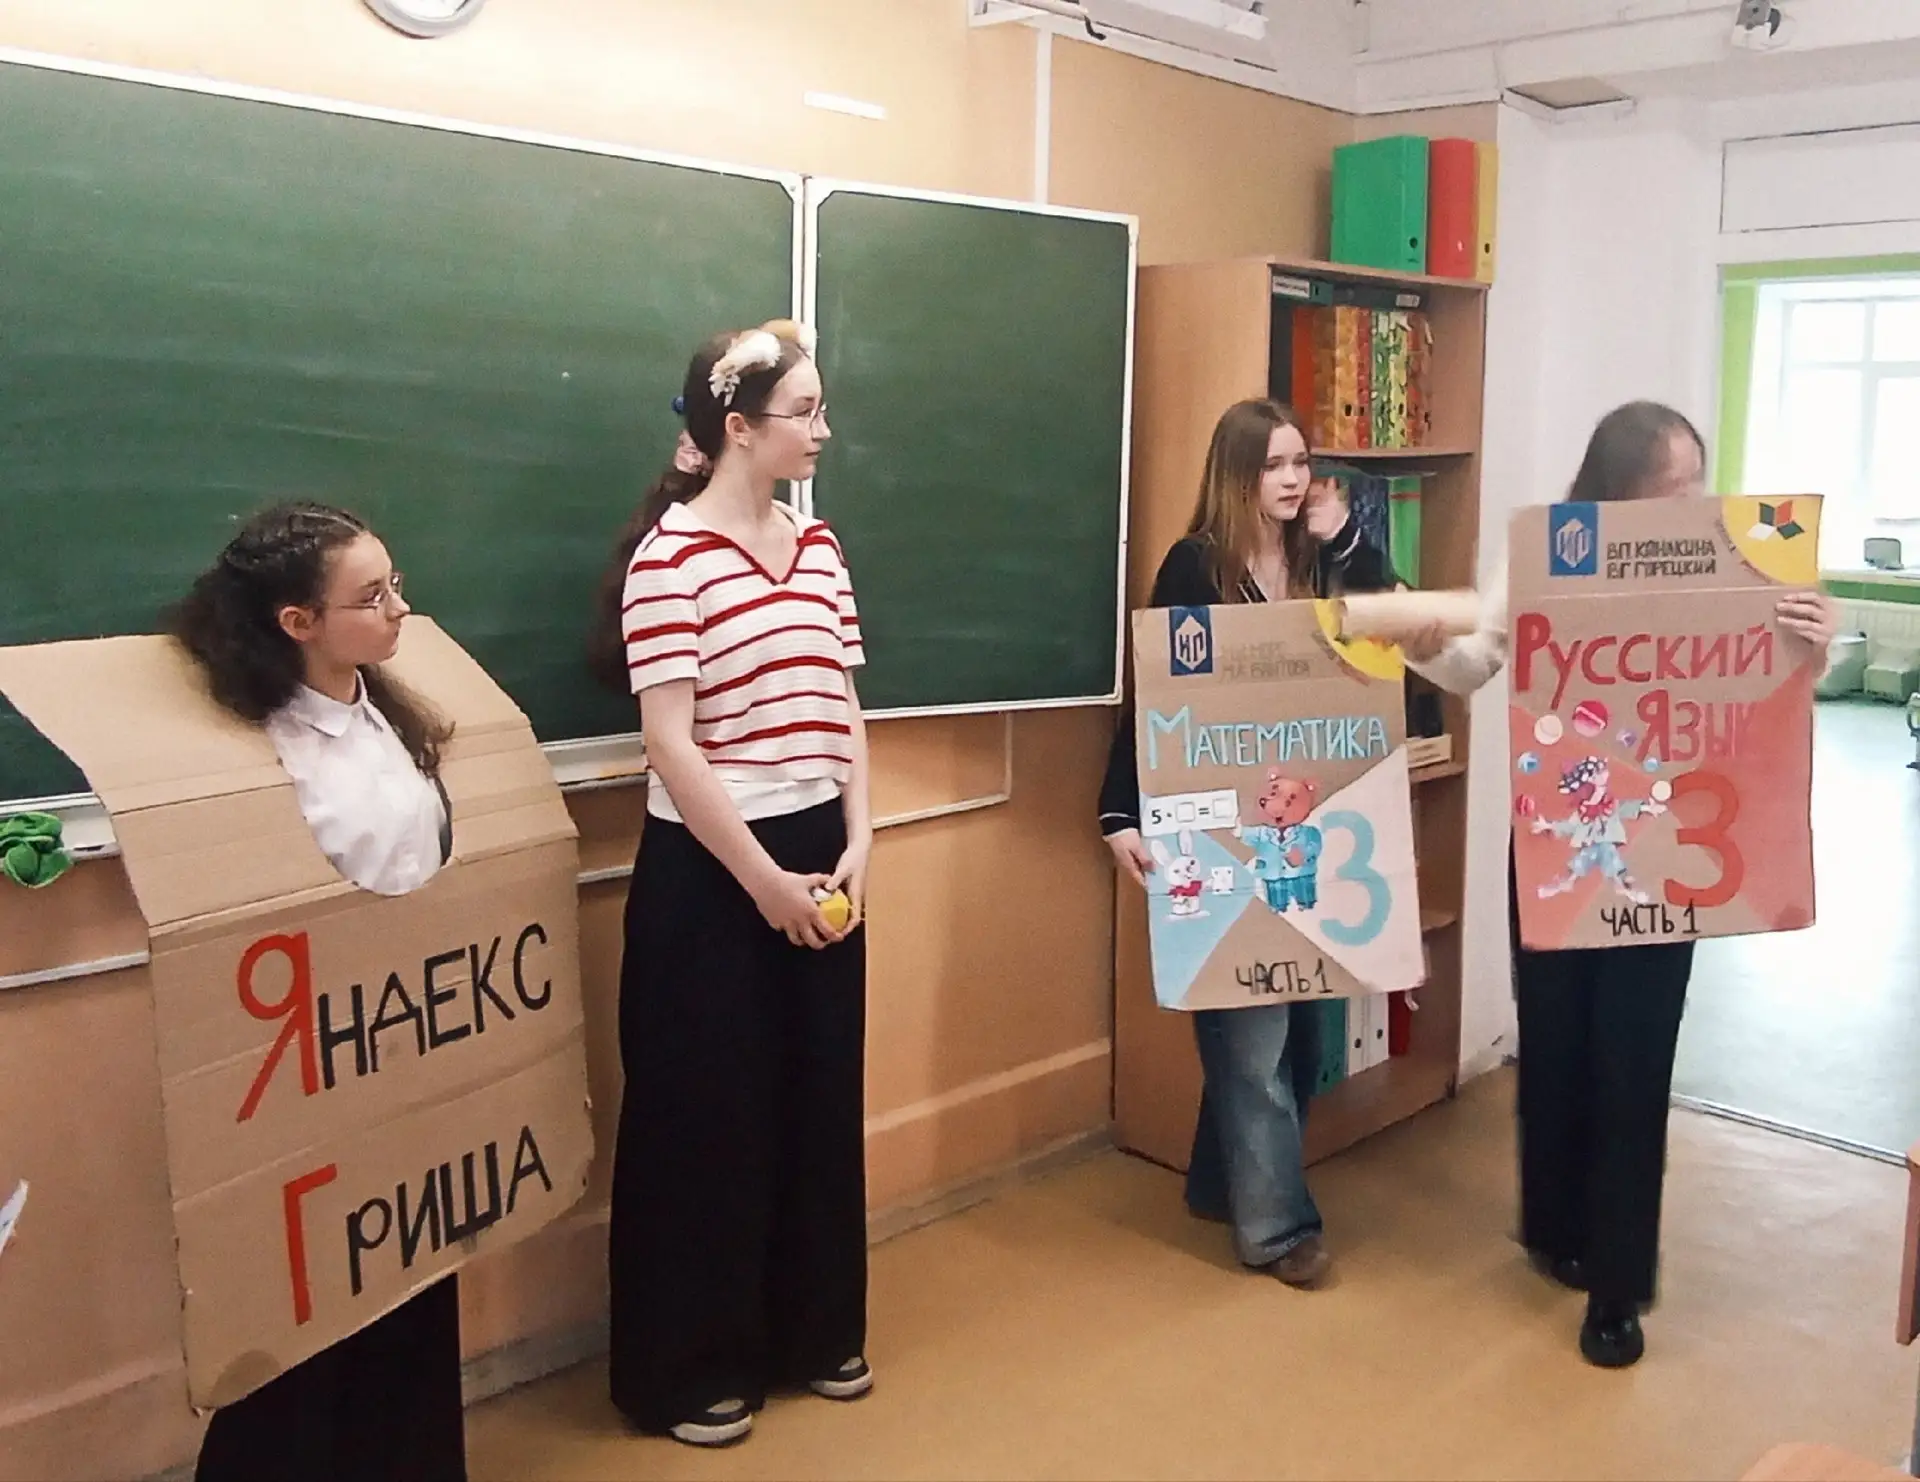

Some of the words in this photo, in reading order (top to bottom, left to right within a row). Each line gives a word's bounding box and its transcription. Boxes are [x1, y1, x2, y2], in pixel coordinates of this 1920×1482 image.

[1147, 704, 1389, 769] МАТЕМАТИКА
[1319, 810, 1391, 947] 3
[1664, 771, 1745, 908] 3
[1600, 903, 1676, 936] ЧАСТЬ
[1681, 906, 1701, 935] 1
[236, 923, 552, 1123] ЯНДЕКС
[1235, 961, 1309, 995] ЧАСТЬ
[1313, 958, 1334, 995] 1
